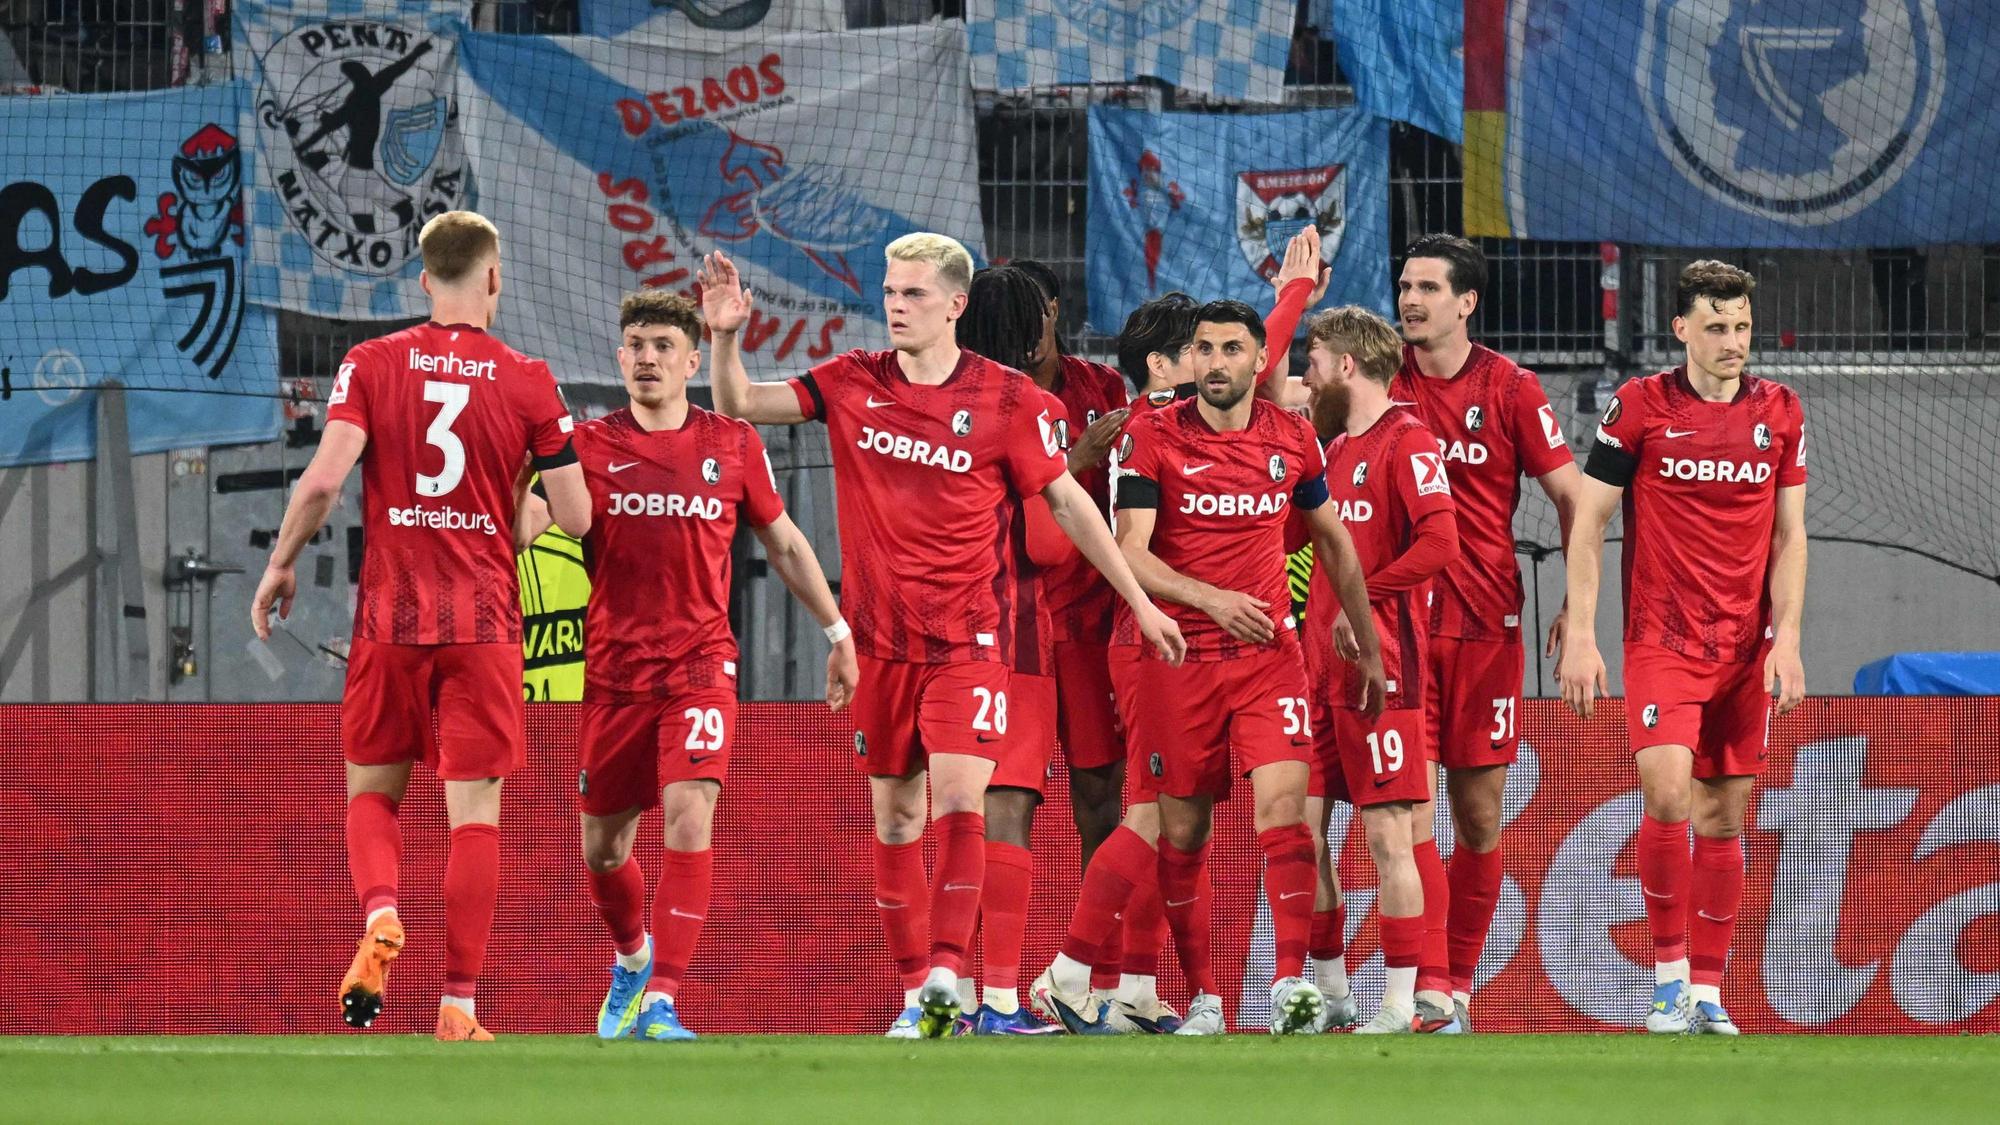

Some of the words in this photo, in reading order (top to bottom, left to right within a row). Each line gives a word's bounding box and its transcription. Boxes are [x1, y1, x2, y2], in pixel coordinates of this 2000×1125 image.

[615, 52, 785, 138] DEZAOS
[277, 168, 393, 268] NATXO
[409, 347, 498, 381] lienhart
[414, 380, 471, 498] 3
[856, 426, 973, 474] JOBRAD
[1658, 456, 1772, 485] JOBRAD
[388, 505, 498, 536] scfreiburg
[606, 492, 724, 521] JOBRAD
[1178, 491, 1288, 516] JOBRAD
[684, 707, 725, 751] 29
[971, 686, 1007, 735] 28
[1489, 696, 1516, 741] 31
[1365, 728, 1405, 773] 19
